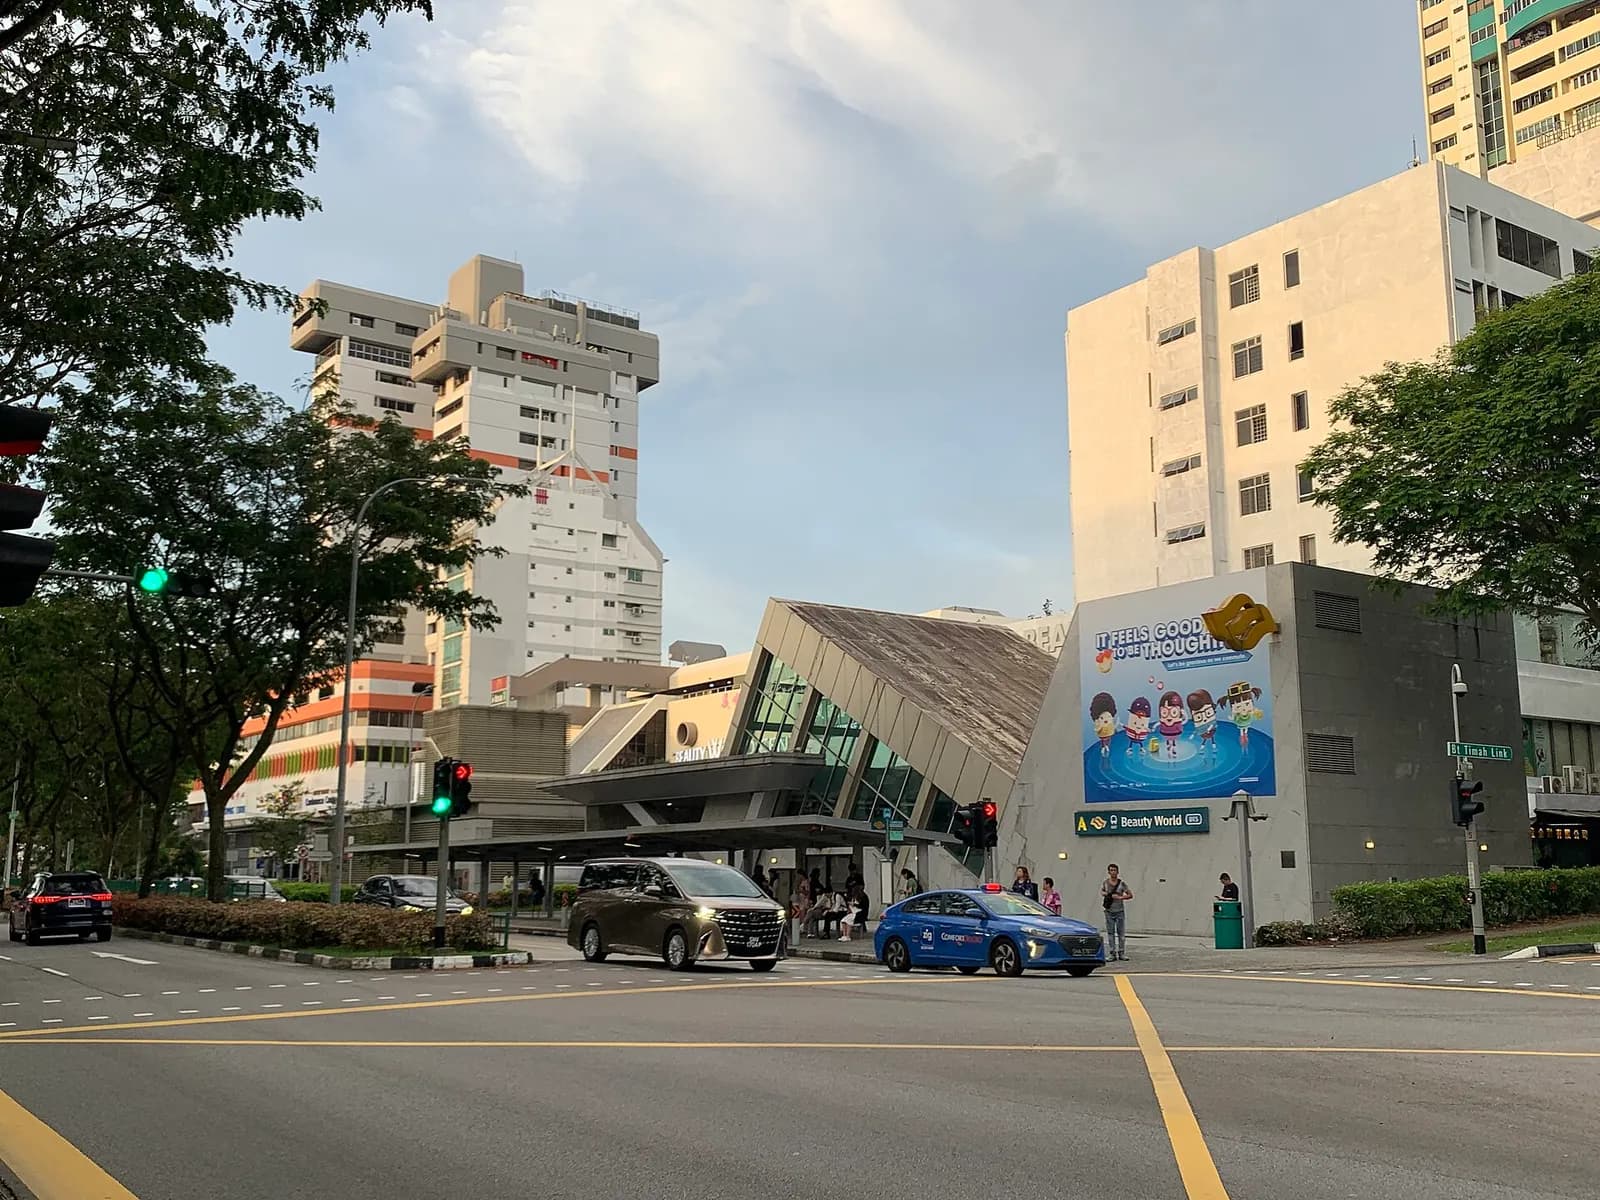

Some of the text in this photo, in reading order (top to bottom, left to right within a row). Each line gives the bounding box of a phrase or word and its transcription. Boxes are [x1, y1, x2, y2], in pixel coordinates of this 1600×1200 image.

[1096, 618, 1203, 649] IT FEELS GOOD
[1112, 647, 1125, 659] TO
[1127, 645, 1140, 657] BE
[1464, 745, 1488, 757] Timah
[1491, 747, 1509, 758] Link
[1077, 816, 1087, 831] A
[1121, 816, 1152, 829] Beauty
[1154, 814, 1182, 826] World
[922, 928, 933, 942] zig
